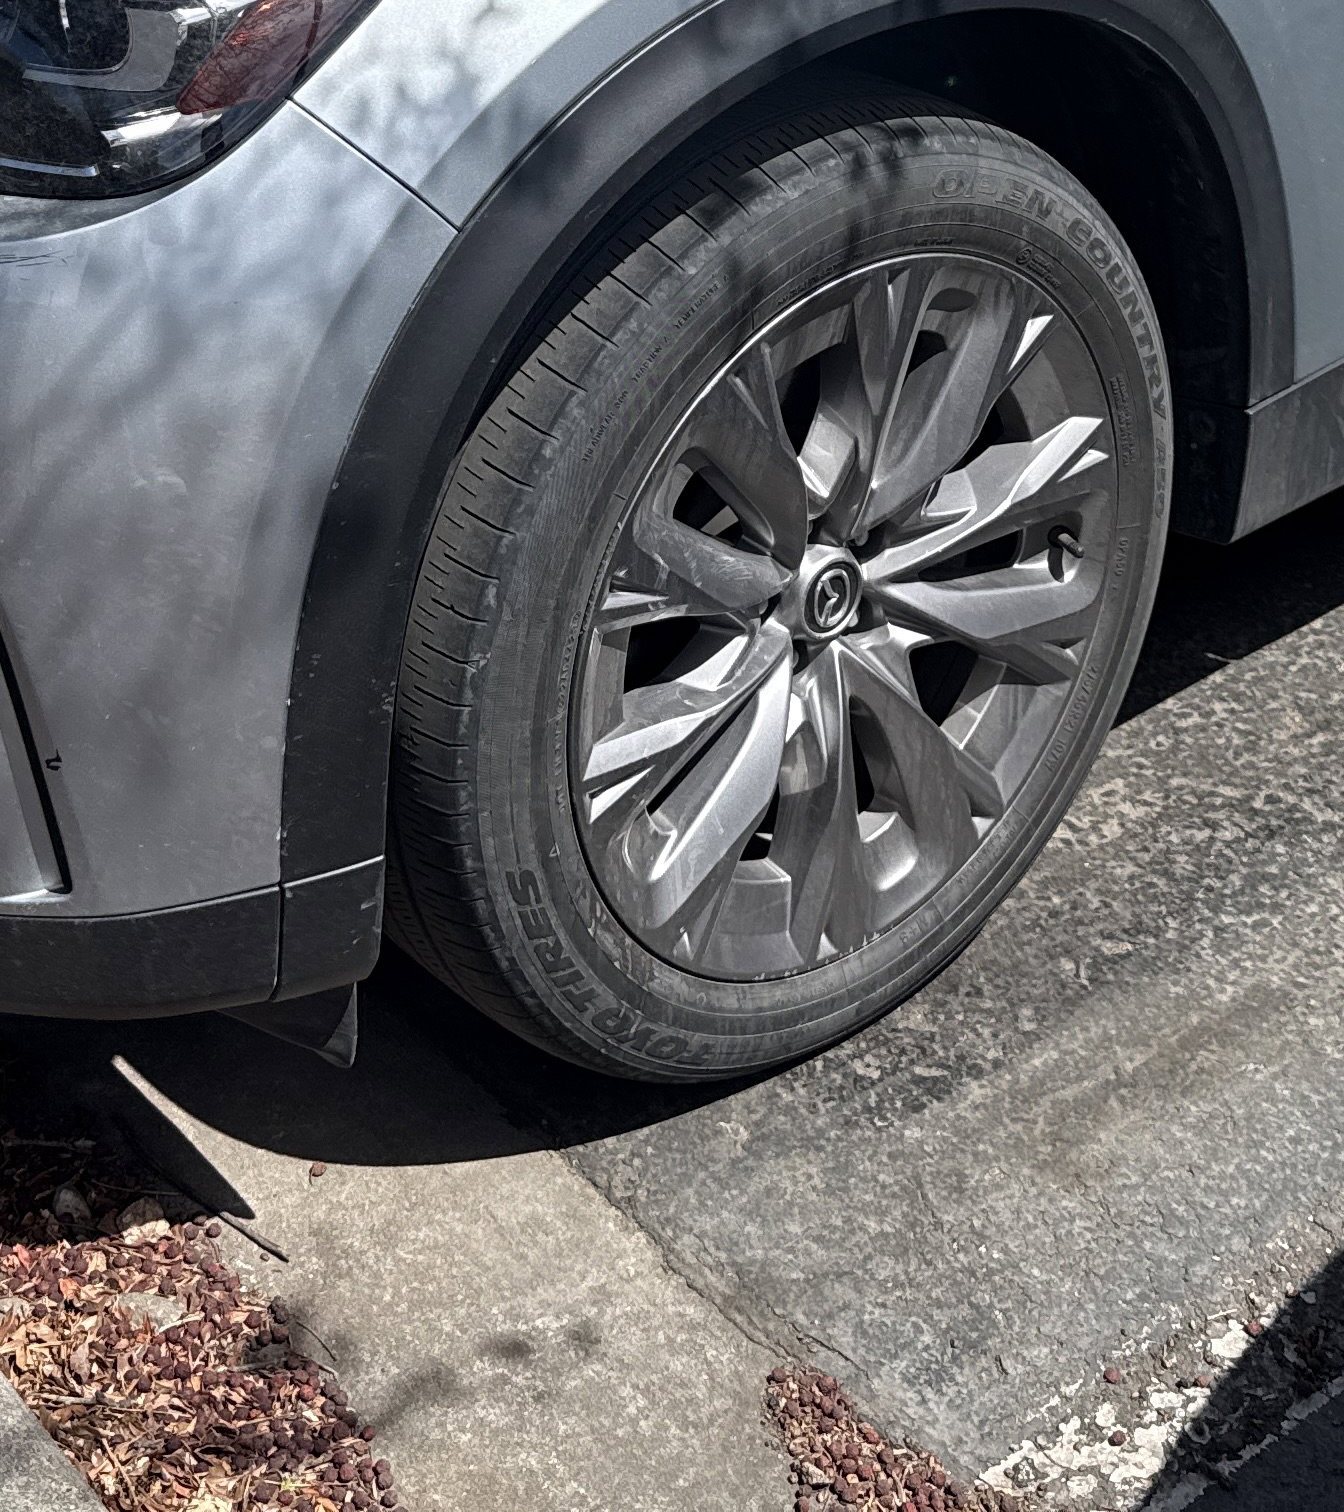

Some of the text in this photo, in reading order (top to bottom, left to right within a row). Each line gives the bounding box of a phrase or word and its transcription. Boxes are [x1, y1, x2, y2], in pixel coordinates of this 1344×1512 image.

[932, 168, 1056, 220] OPEN
[1065, 216, 1167, 421] COUNTRY
[506, 869, 714, 1065] TOYO TIRES
